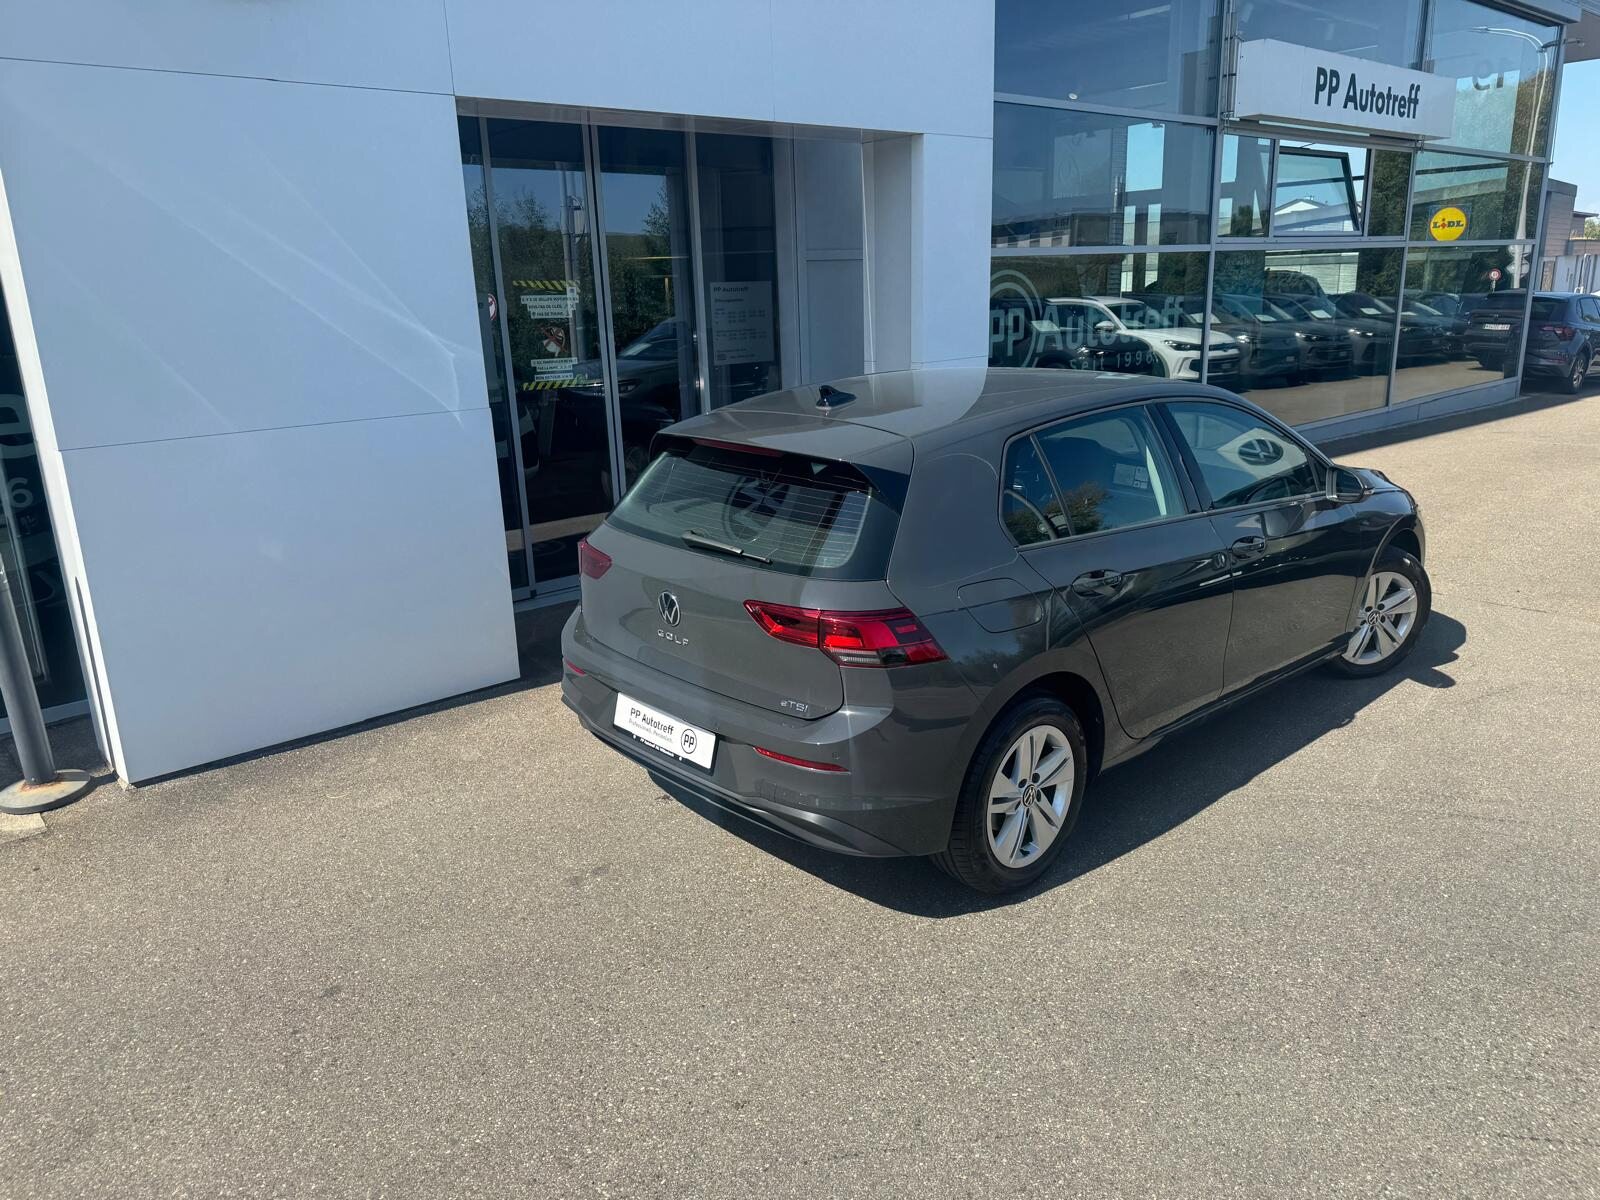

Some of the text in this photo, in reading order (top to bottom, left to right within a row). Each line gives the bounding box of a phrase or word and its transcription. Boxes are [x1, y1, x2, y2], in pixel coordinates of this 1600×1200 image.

[1314, 66, 1421, 119] PP Autotreff
[657, 628, 689, 647] GOLF
[780, 700, 809, 713] eTSI
[630, 707, 674, 736] PP Autotreff
[683, 734, 695, 749] PP
